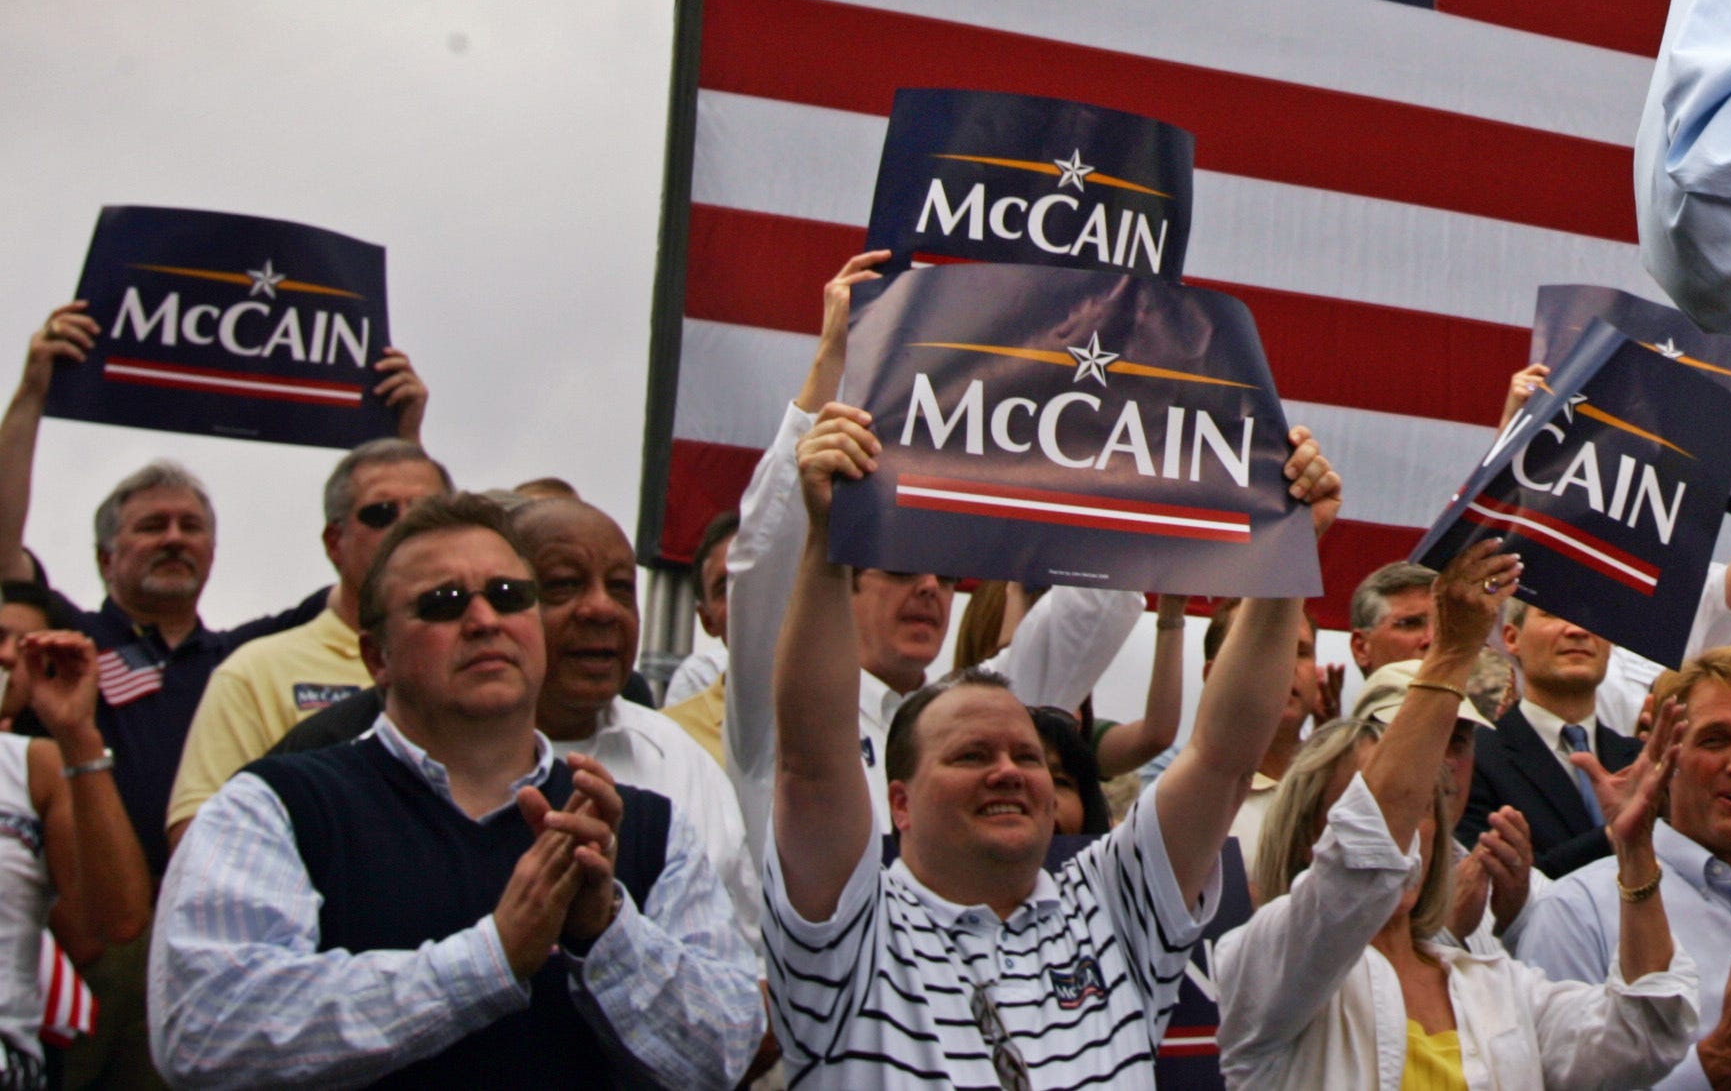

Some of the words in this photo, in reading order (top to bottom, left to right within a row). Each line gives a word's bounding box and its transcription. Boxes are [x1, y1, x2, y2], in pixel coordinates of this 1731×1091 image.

[915, 178, 1168, 274] McCAIN
[110, 286, 370, 368] McCAIN
[900, 373, 1254, 487] McCAIN
[1511, 423, 1686, 545] CAIN
